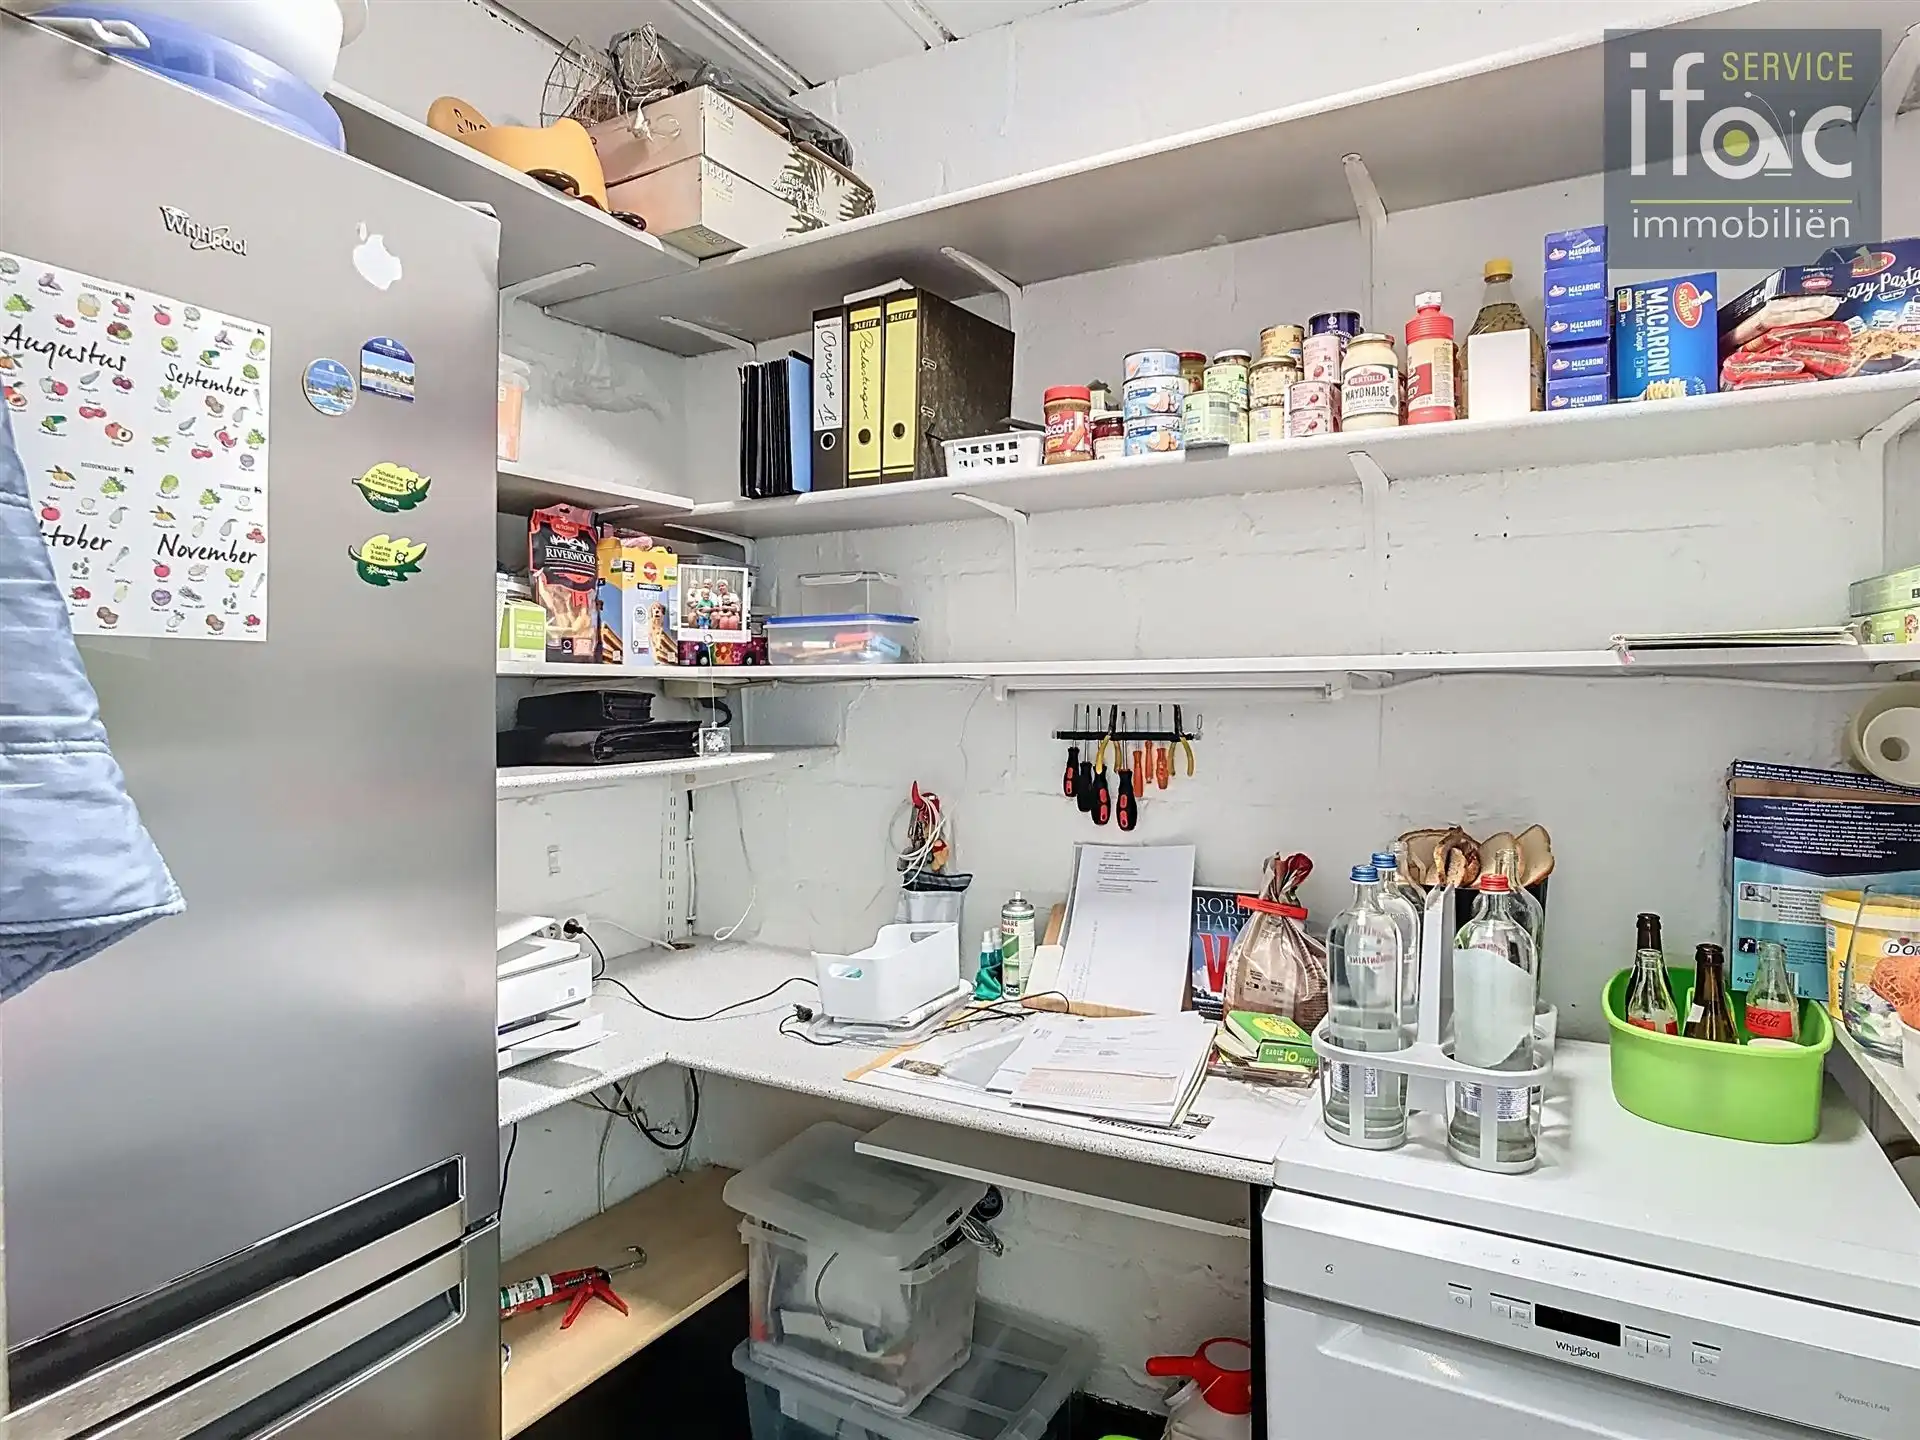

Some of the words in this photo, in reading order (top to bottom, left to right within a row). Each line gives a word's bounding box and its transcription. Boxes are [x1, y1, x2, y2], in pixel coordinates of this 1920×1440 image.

[159, 206, 247, 256] Whirlpool
[1568, 245, 1601, 256] MACARONI
[1568, 282, 1601, 293] MACARONI
[1679, 288, 1695, 321] SOUBRY
[857, 319, 877, 329] LEITZ
[894, 310, 914, 321] LEITZ
[1570, 319, 1603, 329] MACARONI
[1646, 287, 1670, 377] MACARONI
[3, 323, 127, 372] Augustus
[1571, 357, 1604, 367] MACARONI
[165, 362, 249, 397] September
[1350, 374, 1384, 385] BERTOLLI
[1345, 385, 1390, 401] MAYONAISE
[1571, 394, 1603, 404] MACARONI
[40, 520, 112, 551] tober
[157, 533, 257, 565] November
[546, 547, 595, 565] RIVERWOOD
[1196, 897, 1252, 916] ROBE
[1265, 1048, 1284, 1056] EAGLE
[1284, 1050, 1299, 1063] 10
[1090, 1116, 1197, 1140] JUNGHEINRICH
[1555, 1340, 1600, 1360] Whirlpool
